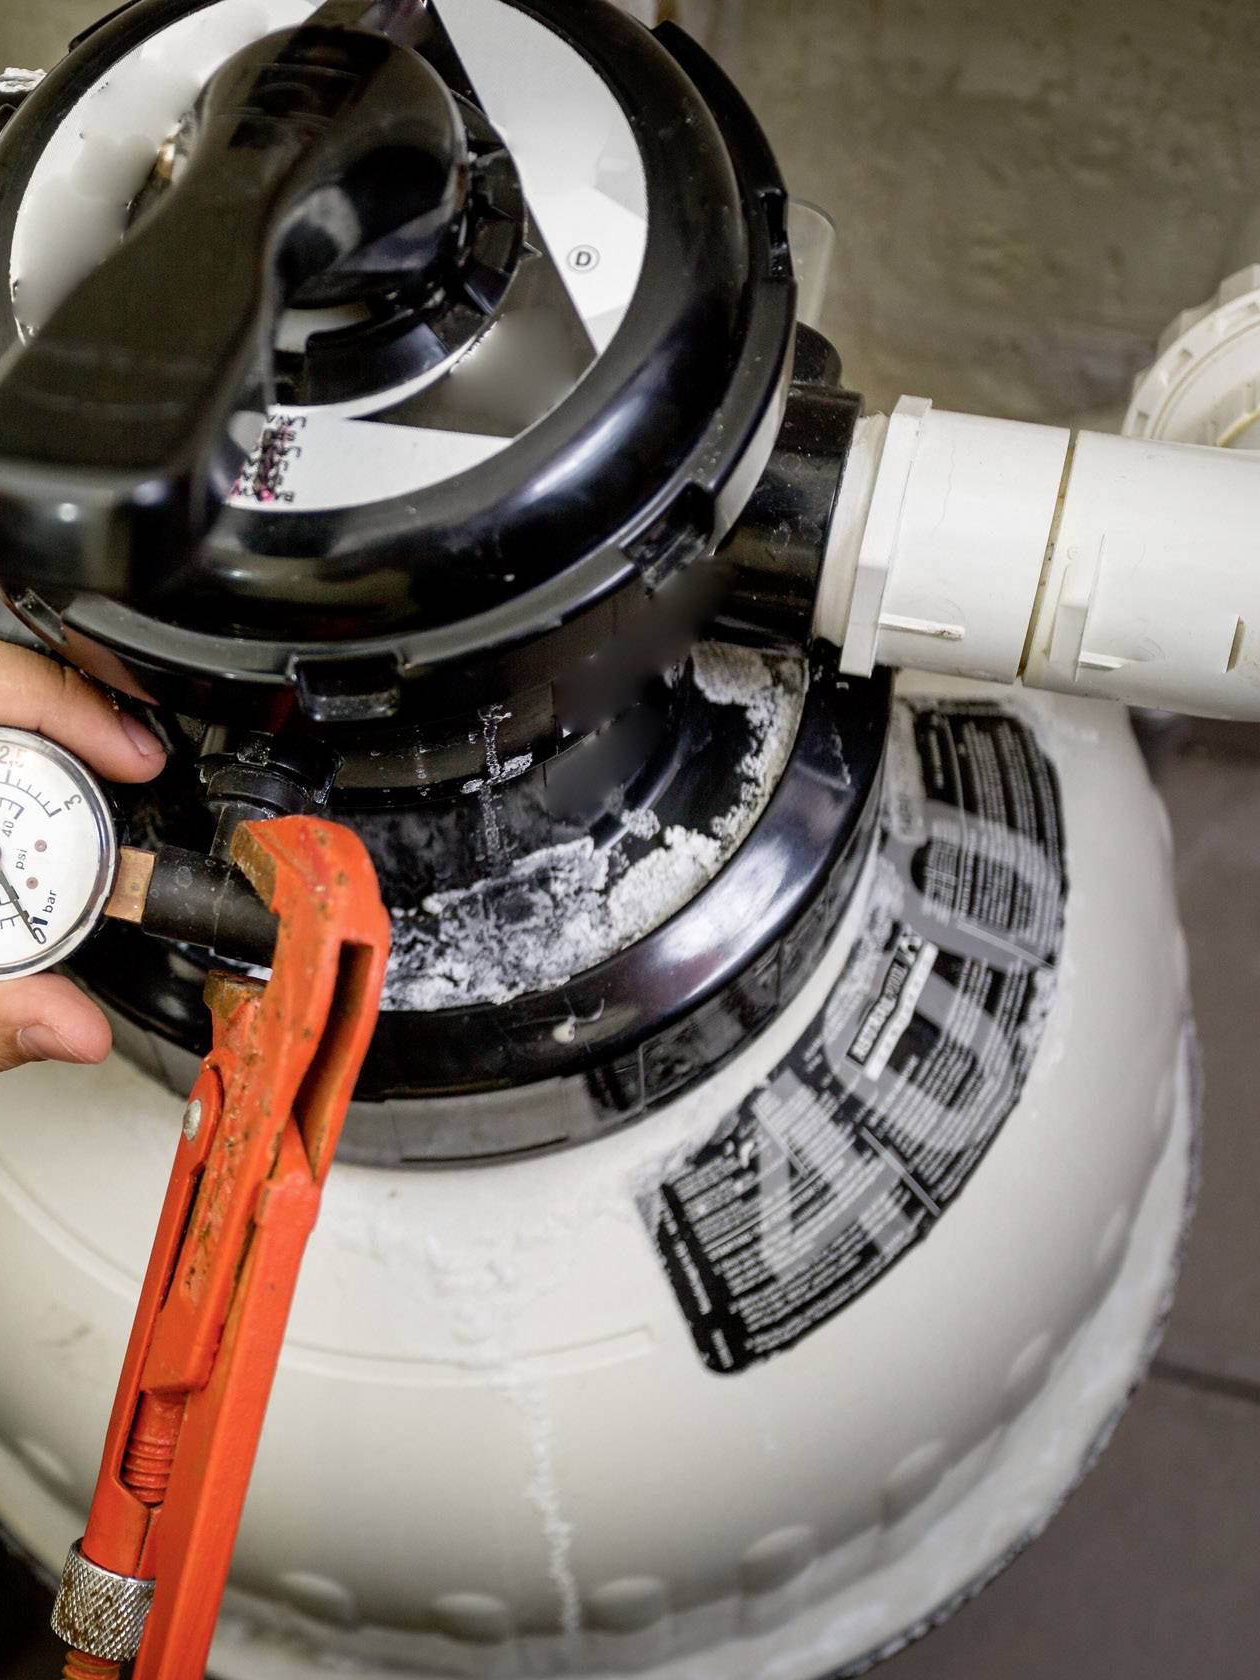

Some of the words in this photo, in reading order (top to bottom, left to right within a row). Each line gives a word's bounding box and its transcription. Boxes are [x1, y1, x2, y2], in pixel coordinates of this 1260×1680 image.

[576, 251, 591, 265] D
[63, 793, 82, 811] 3
[2, 820, 14, 837] 40
[15, 848, 28, 870] psi
[42, 889, 57, 913] bar
[32, 927, 46, 944] 0
